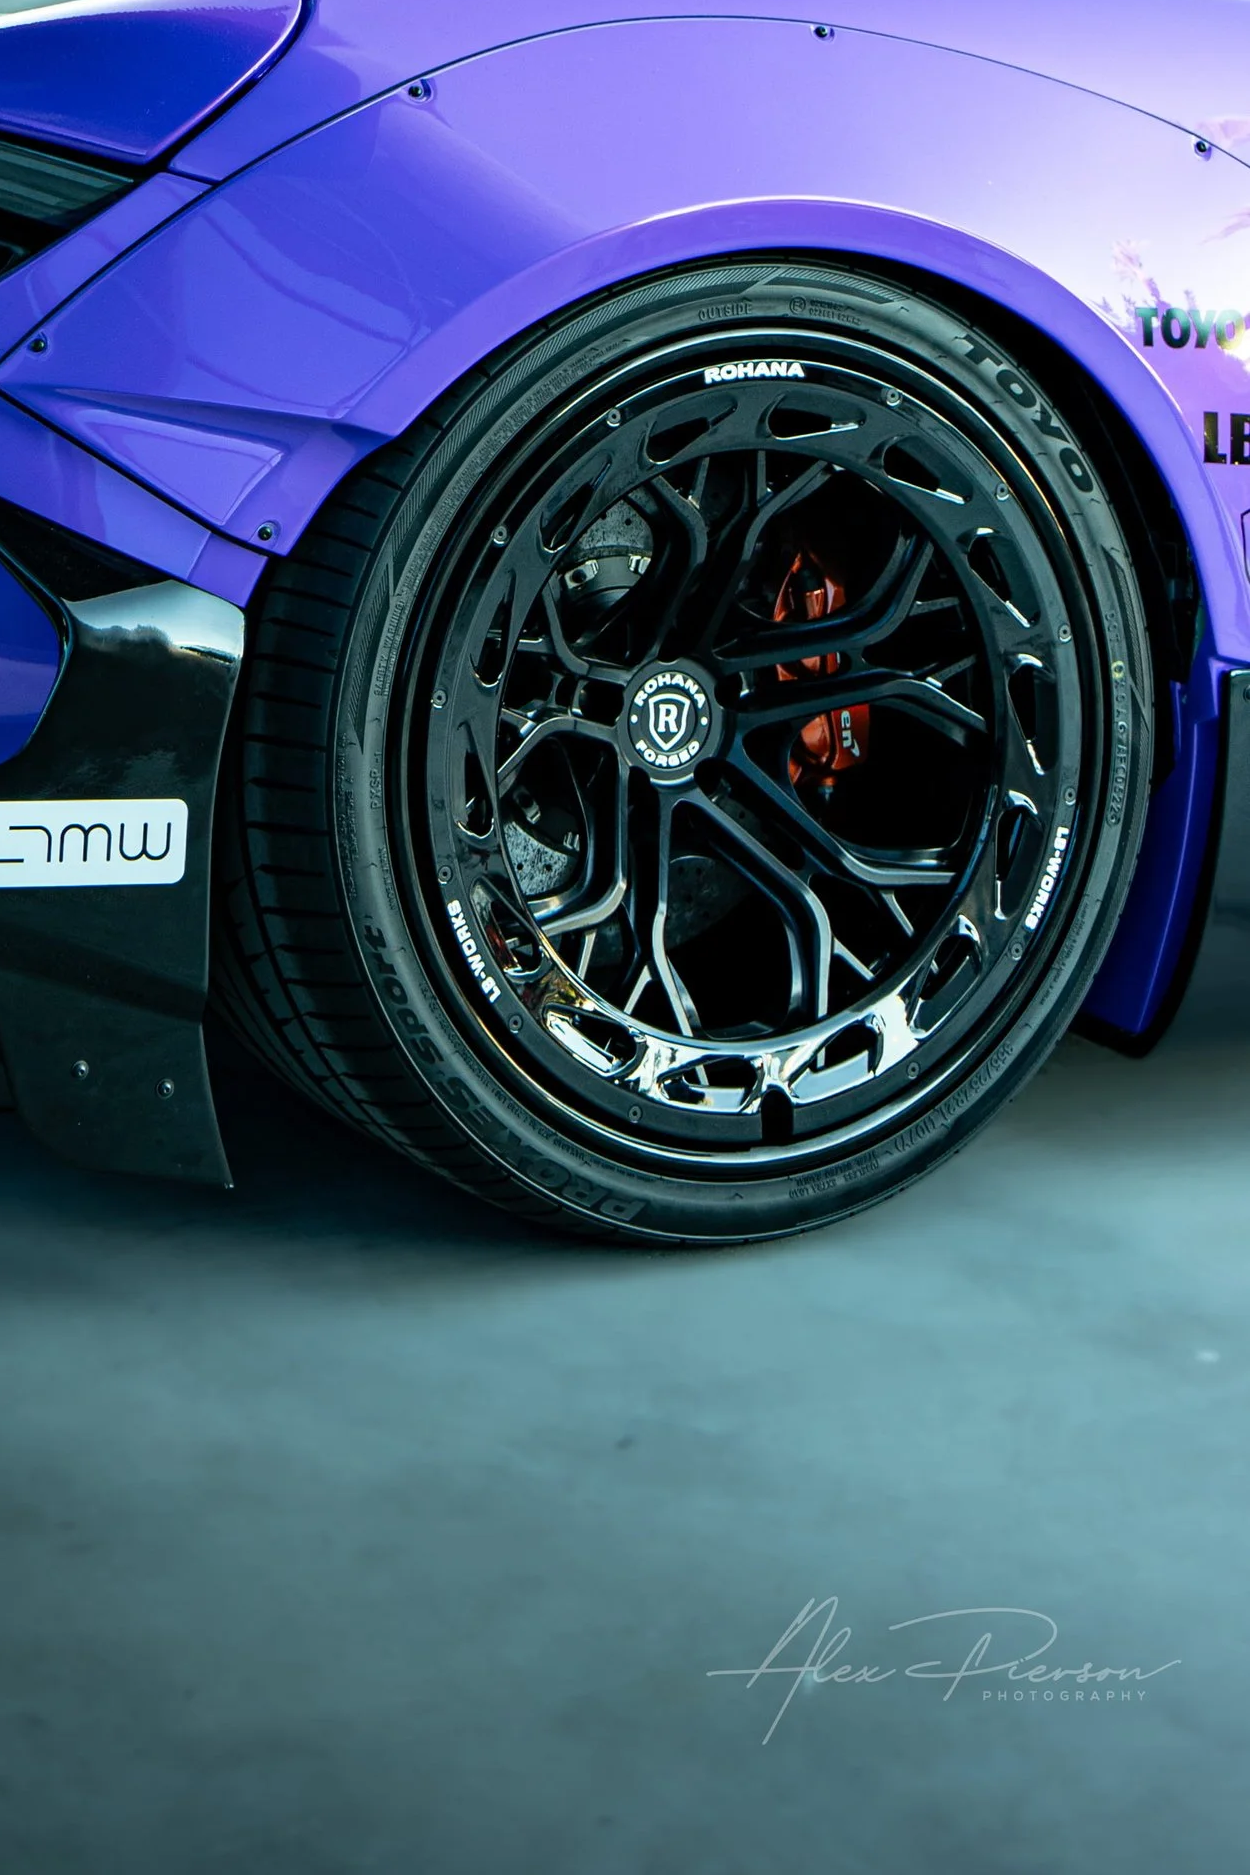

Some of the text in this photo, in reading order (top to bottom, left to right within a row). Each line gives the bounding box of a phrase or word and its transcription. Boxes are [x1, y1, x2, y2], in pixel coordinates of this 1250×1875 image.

[699, 301, 753, 322] OUTSIDE
[1135, 307, 1246, 350] TOYO
[703, 360, 806, 385] ROHANA
[963, 333, 1094, 493] TOYO
[634, 673, 706, 709] ROHANA
[657, 703, 679, 733] R
[635, 739, 700, 767] FORGED
[1024, 825, 1070, 932] LB-WORKS
[446, 899, 502, 1003] LB-WORKS
